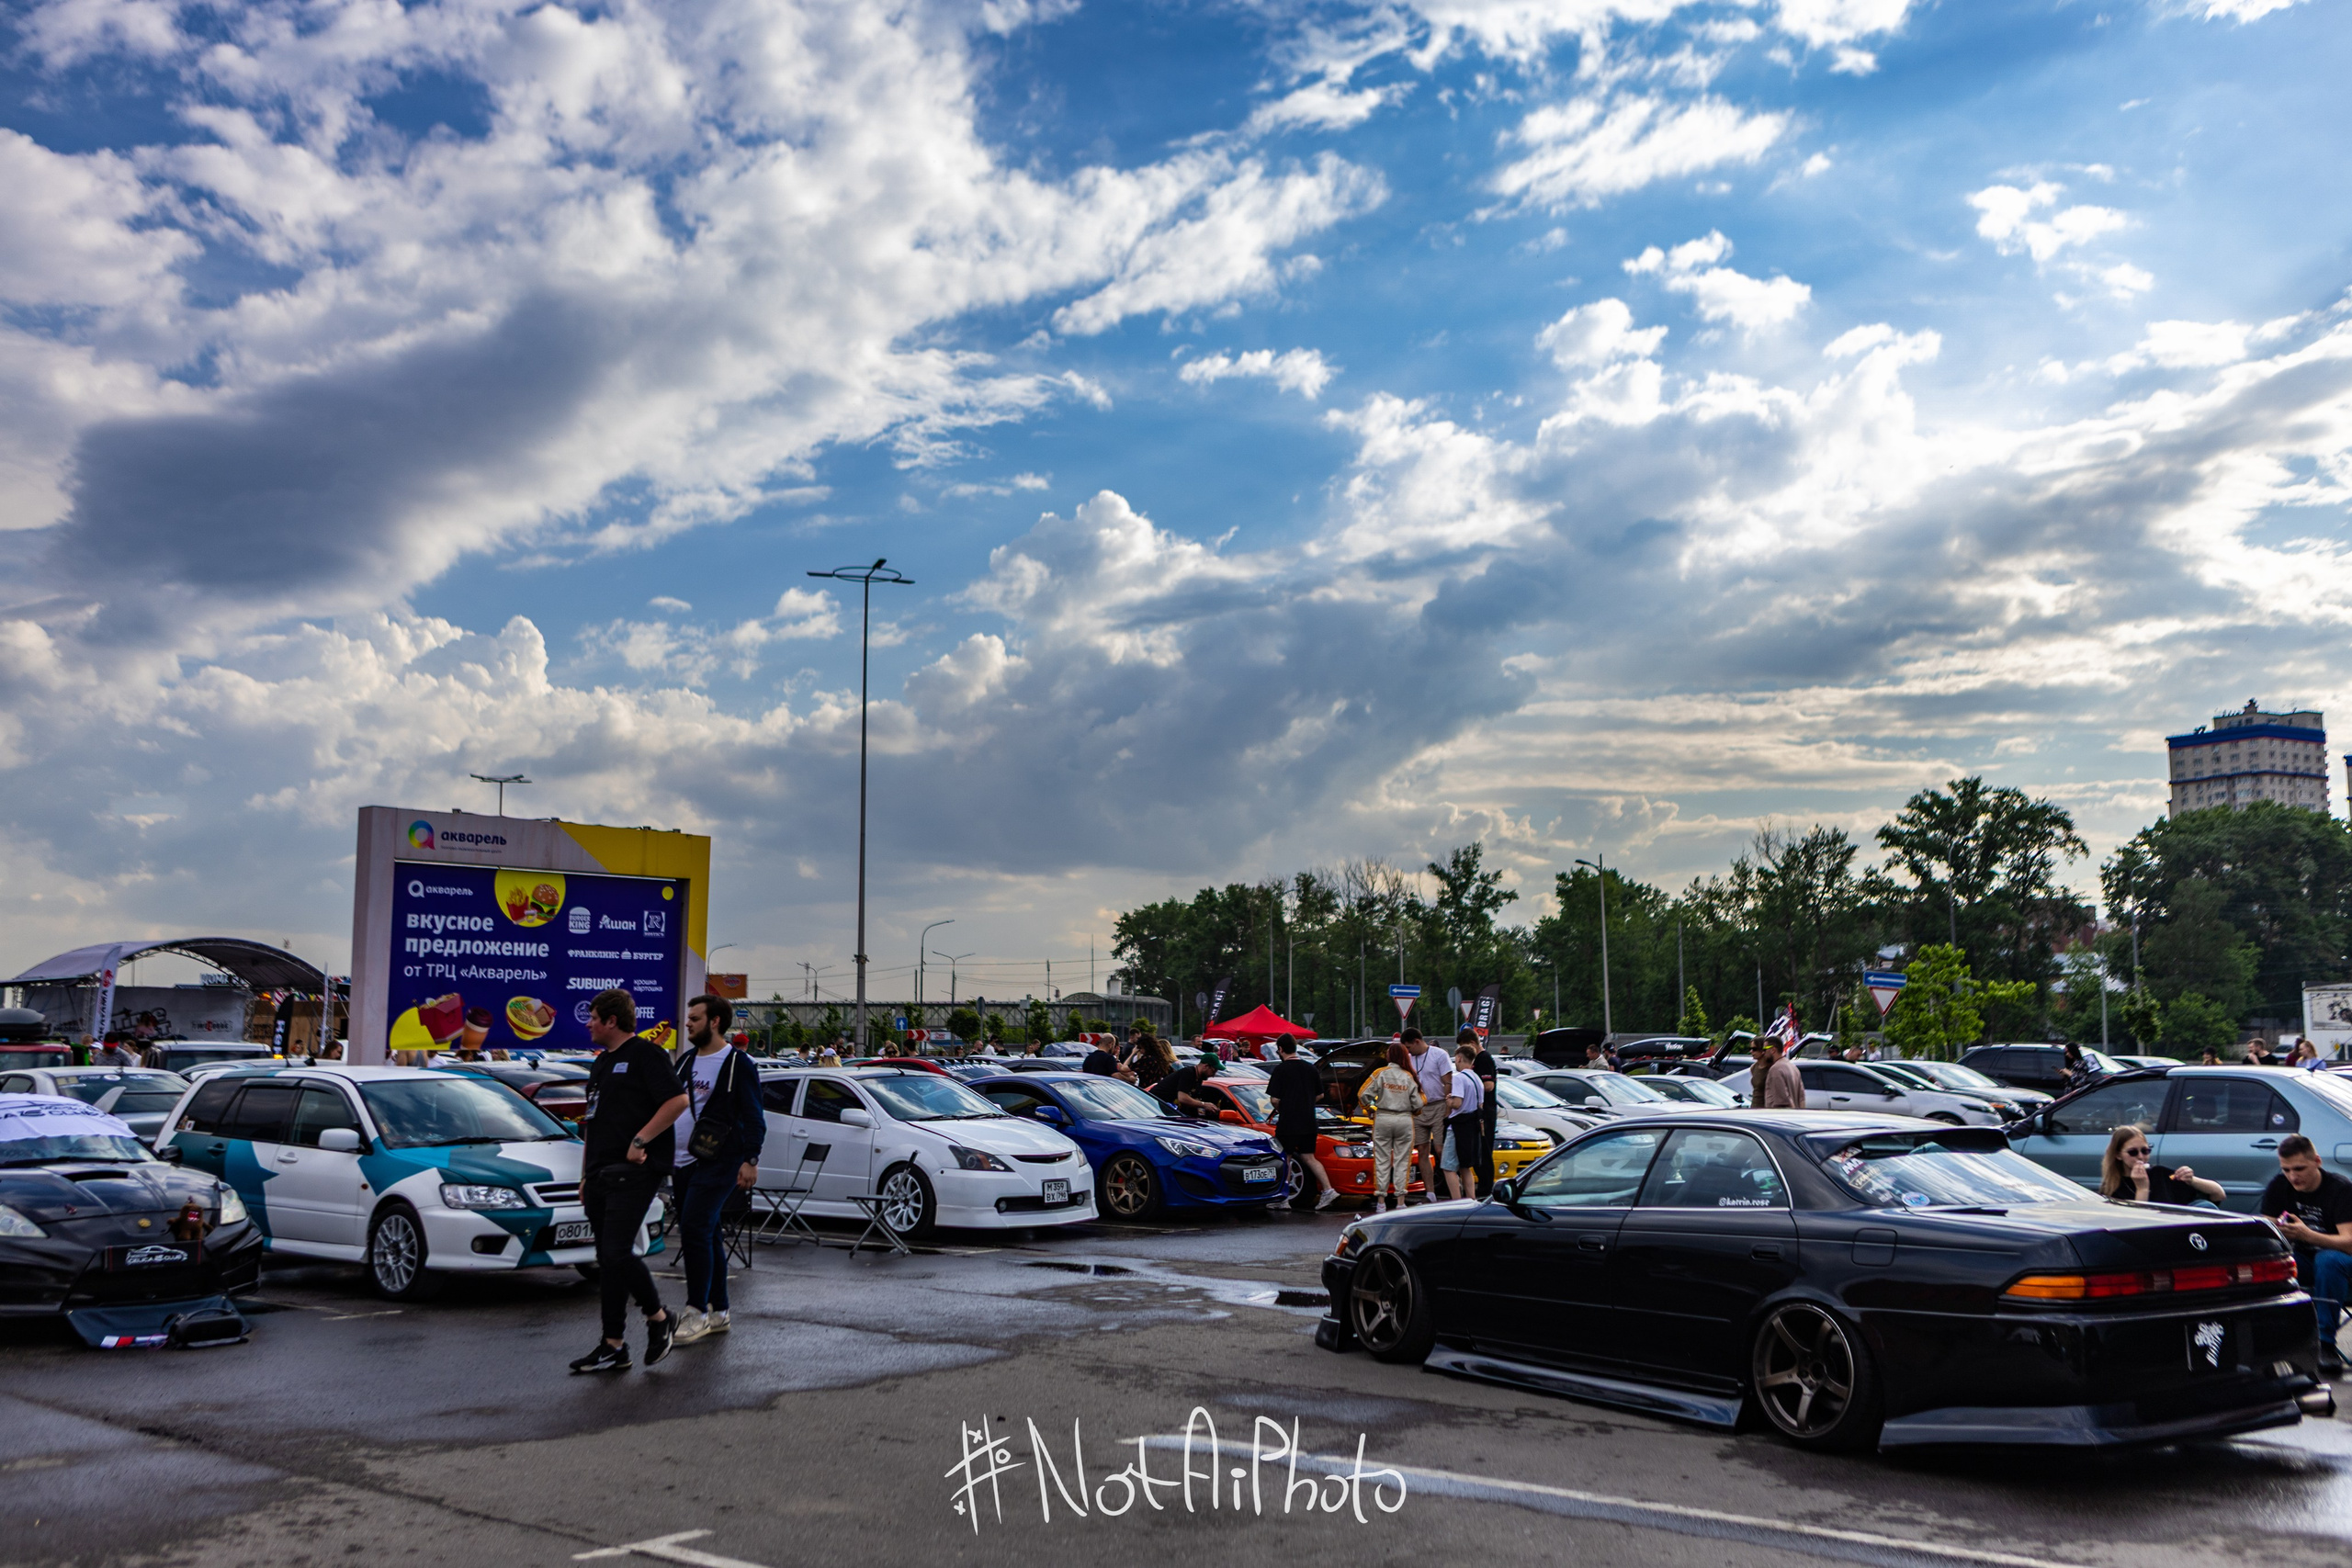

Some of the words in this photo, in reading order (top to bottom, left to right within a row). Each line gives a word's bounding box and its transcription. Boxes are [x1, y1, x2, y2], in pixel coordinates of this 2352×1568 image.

[441, 830, 507, 846] акварель
[425, 885, 474, 897] акварель
[406, 913, 494, 934] вкусное
[569, 920, 591, 930] KING
[599, 914, 637, 931] Ашан
[404, 937, 549, 958] предложение
[632, 952, 664, 961] БУРГЕР
[403, 965, 423, 977] от
[426, 964, 457, 981] ТРЦ
[459, 964, 548, 983] «Акварель»
[566, 977, 625, 990] SUBWAY
